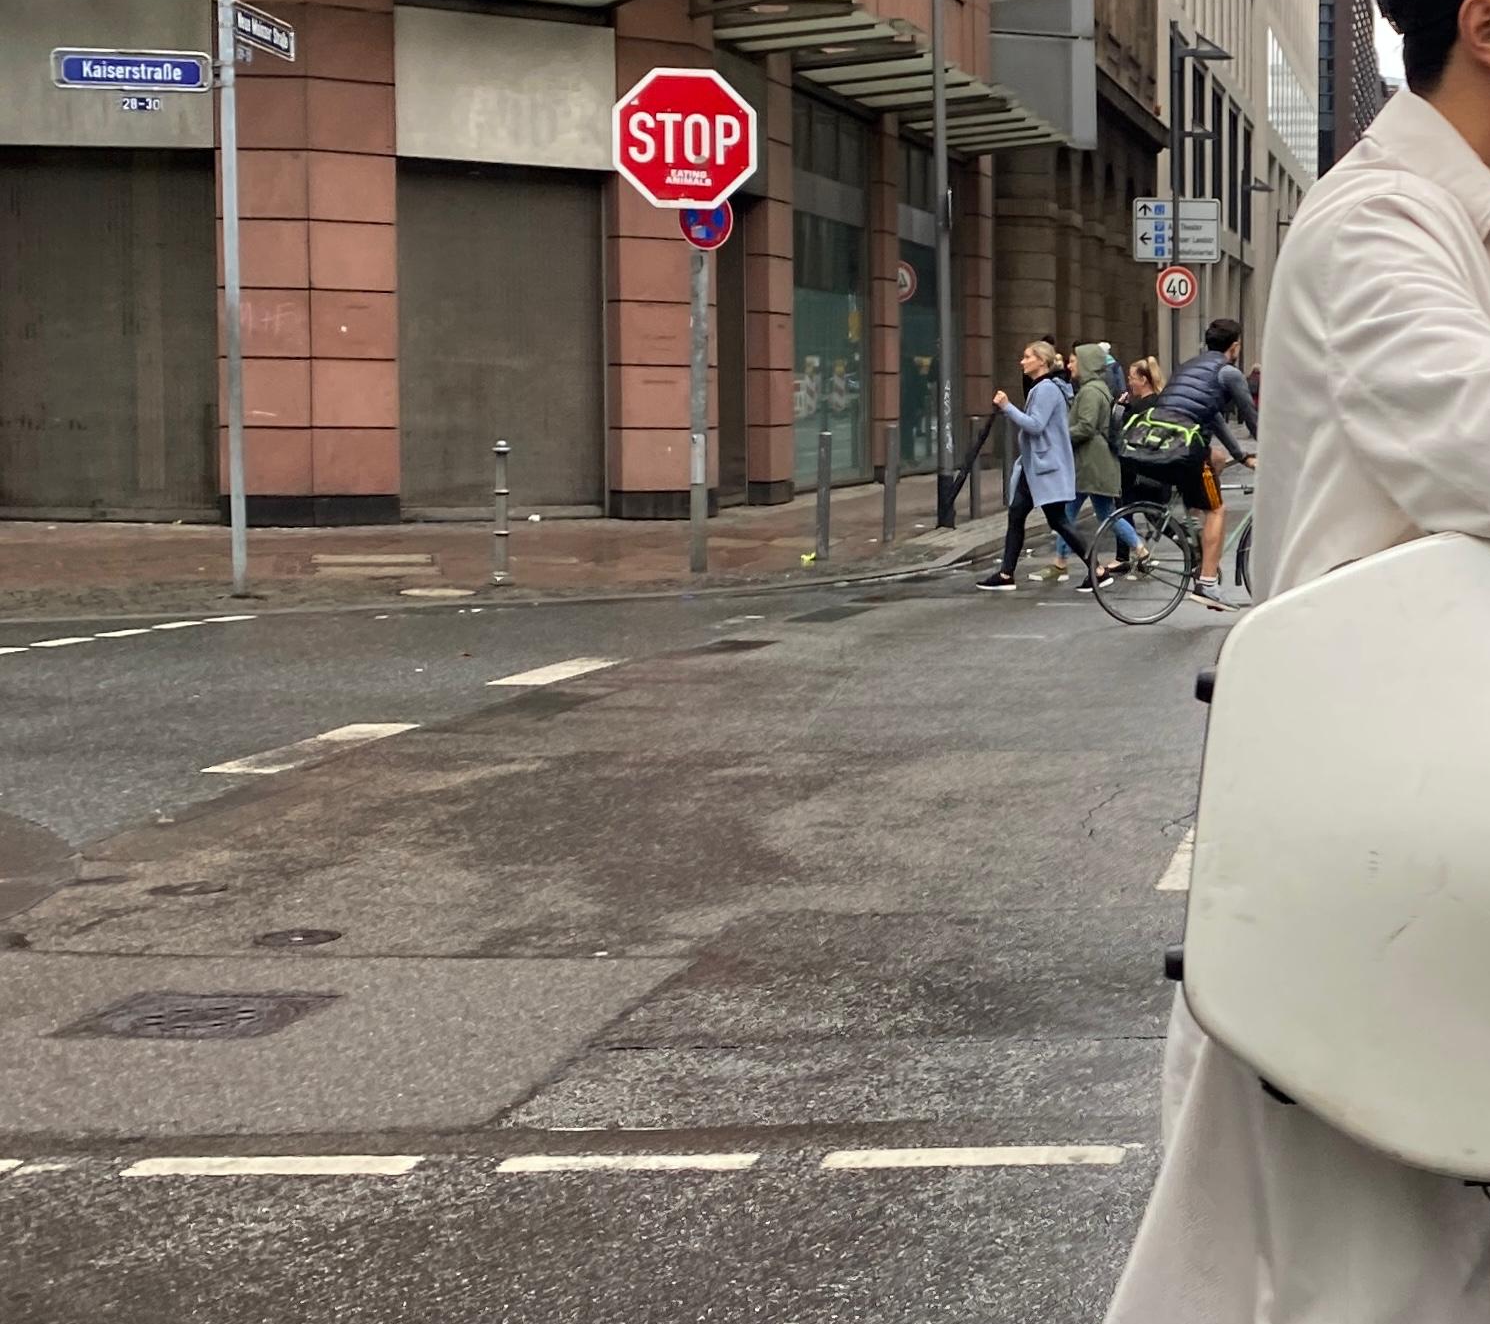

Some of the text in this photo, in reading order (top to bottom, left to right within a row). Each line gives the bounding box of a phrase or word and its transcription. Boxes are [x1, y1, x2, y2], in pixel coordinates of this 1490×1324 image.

[82, 60, 182, 82] Kaiserstraße
[123, 98, 161, 111] 28-30
[627, 111, 742, 166] STOP
[1166, 278, 1189, 296] 40
